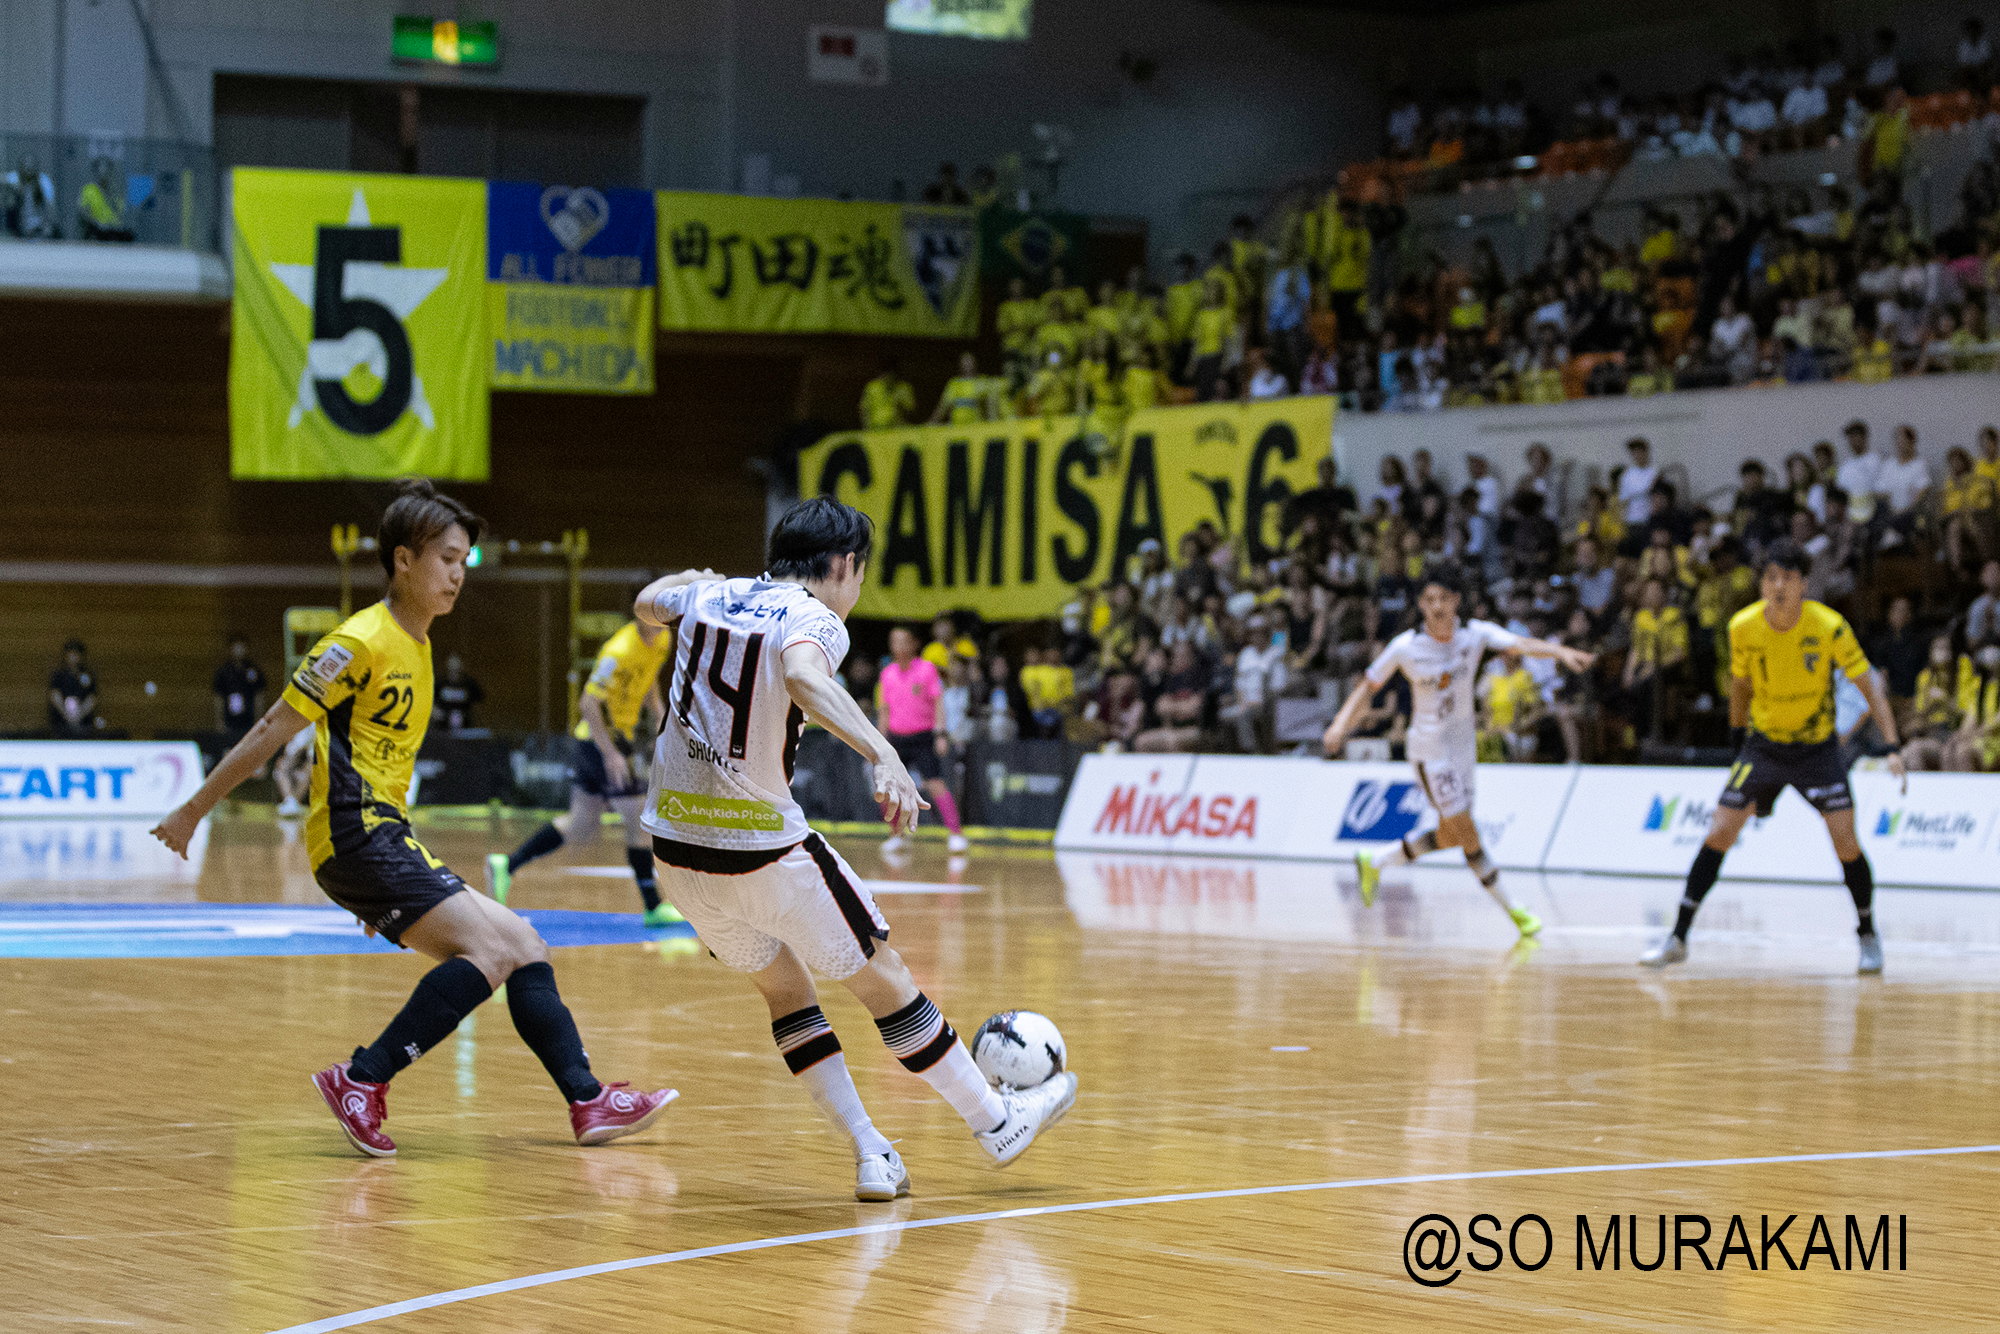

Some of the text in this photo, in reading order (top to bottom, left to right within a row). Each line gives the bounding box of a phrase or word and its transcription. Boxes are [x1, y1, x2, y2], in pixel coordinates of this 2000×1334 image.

[311, 224, 412, 437] 5
[369, 686, 414, 731] 22
[677, 621, 765, 761] 14
[687, 738, 740, 773] SHUN
[996, 1124, 1030, 1153] ATHLETA
